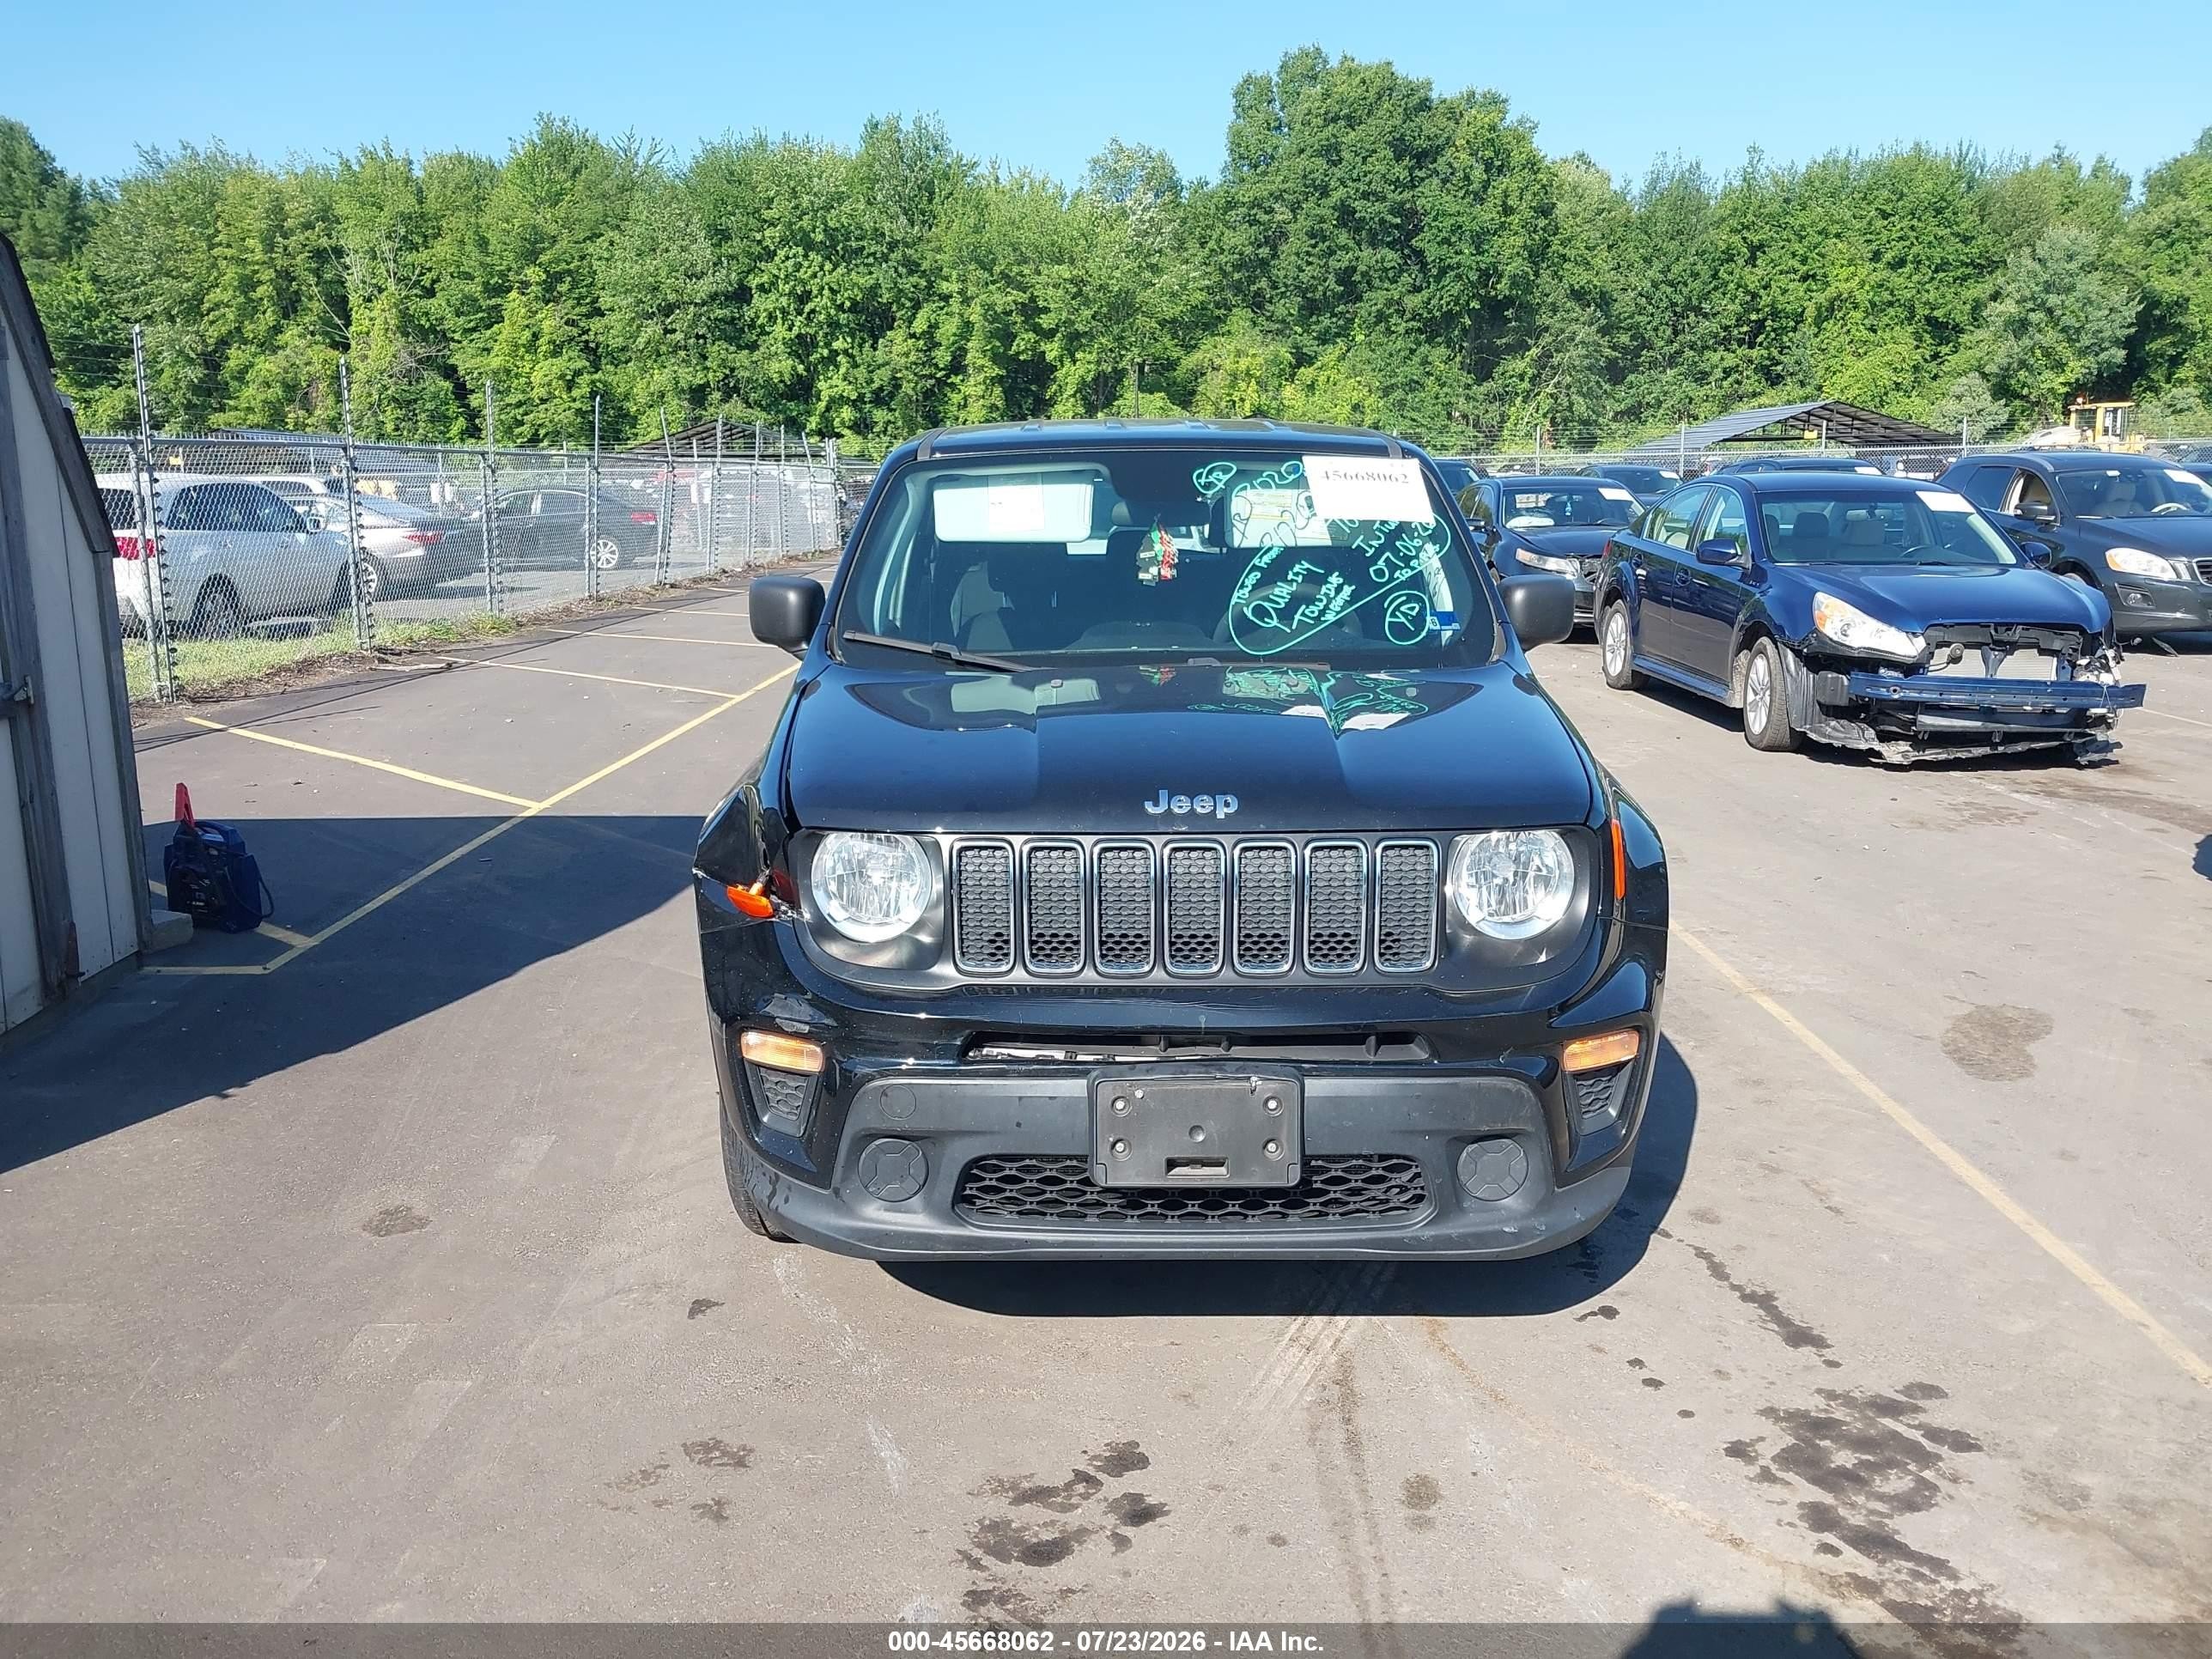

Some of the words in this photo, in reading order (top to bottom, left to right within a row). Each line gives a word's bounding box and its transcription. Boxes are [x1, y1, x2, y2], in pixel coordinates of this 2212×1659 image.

[1322, 470, 1409, 484] 45668062
[1243, 560, 1325, 633] QUALITY
[1291, 571, 1344, 629] TOWING
[1144, 789, 1238, 819] Jeep
